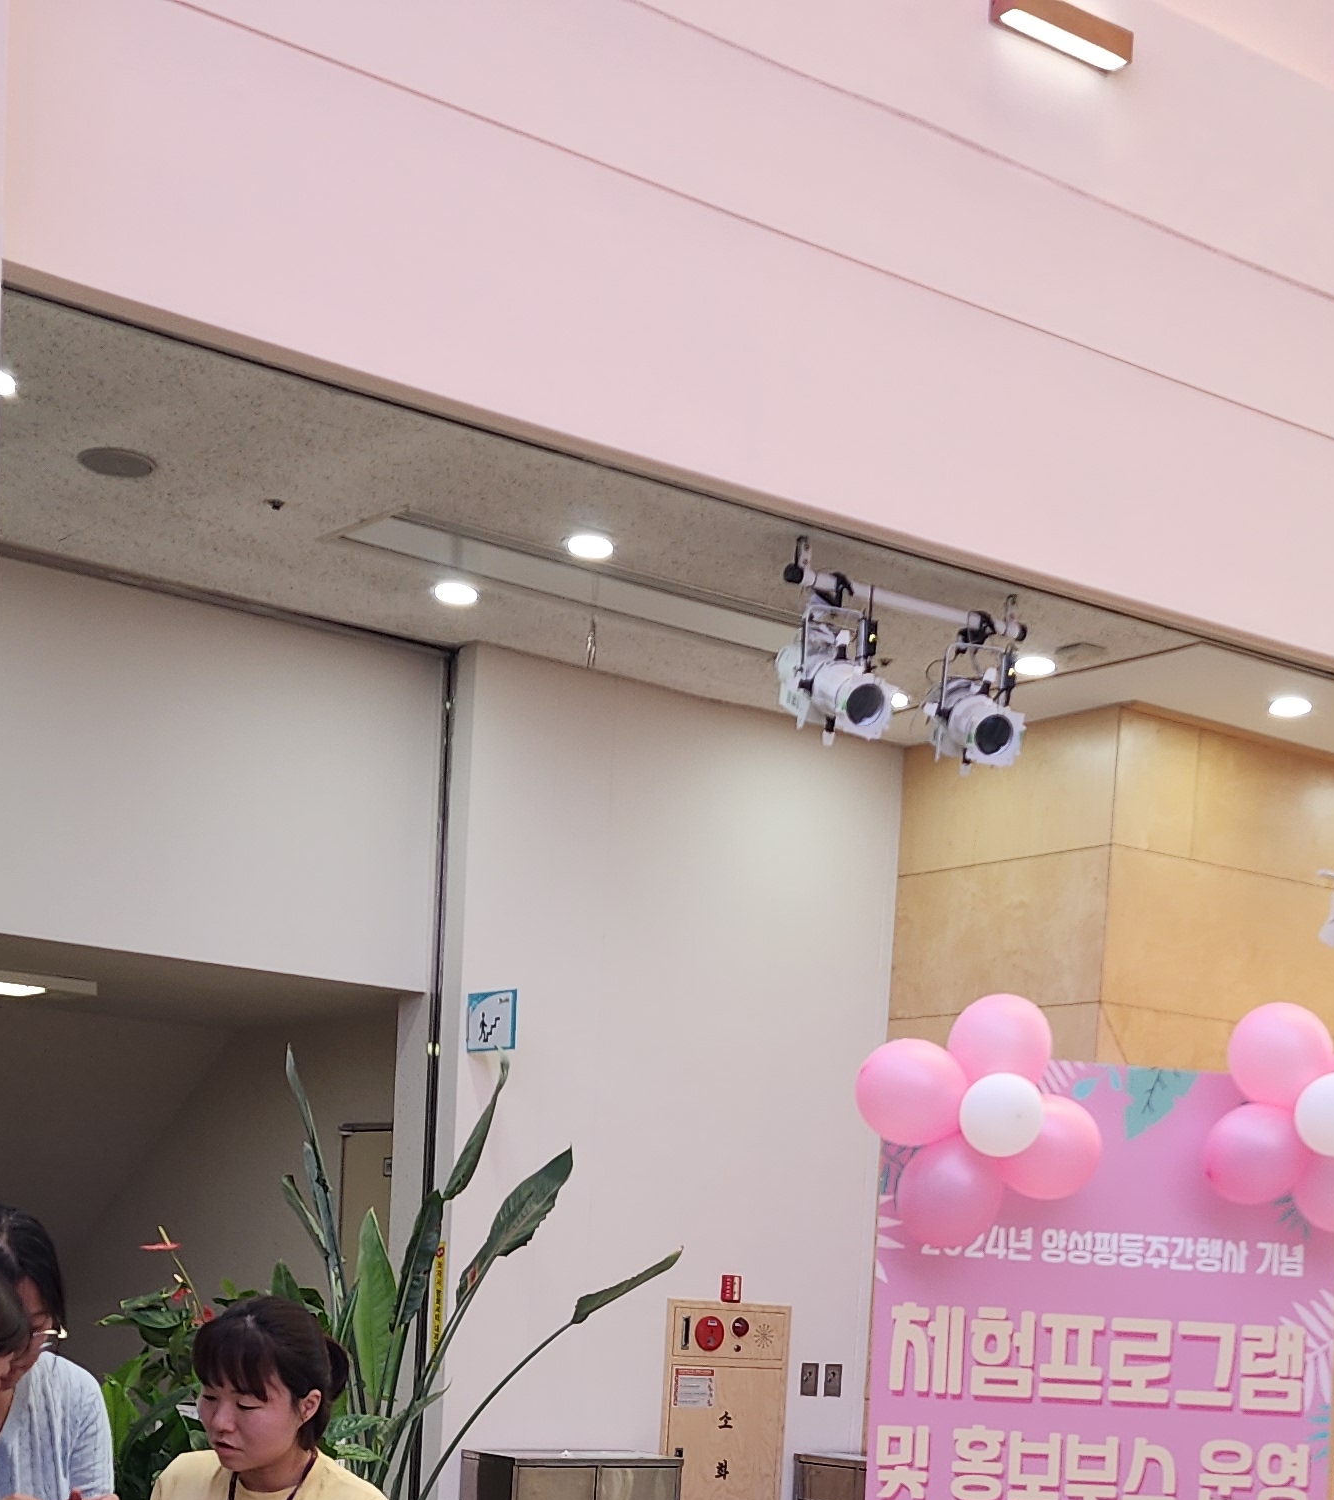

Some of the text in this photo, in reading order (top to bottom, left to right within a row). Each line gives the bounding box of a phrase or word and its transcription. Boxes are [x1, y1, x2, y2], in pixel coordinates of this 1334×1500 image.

[922, 1225, 1305, 1278] 24년 양성평등주간행사 기념
[889, 1302, 1307, 1414] 체험프로그램
